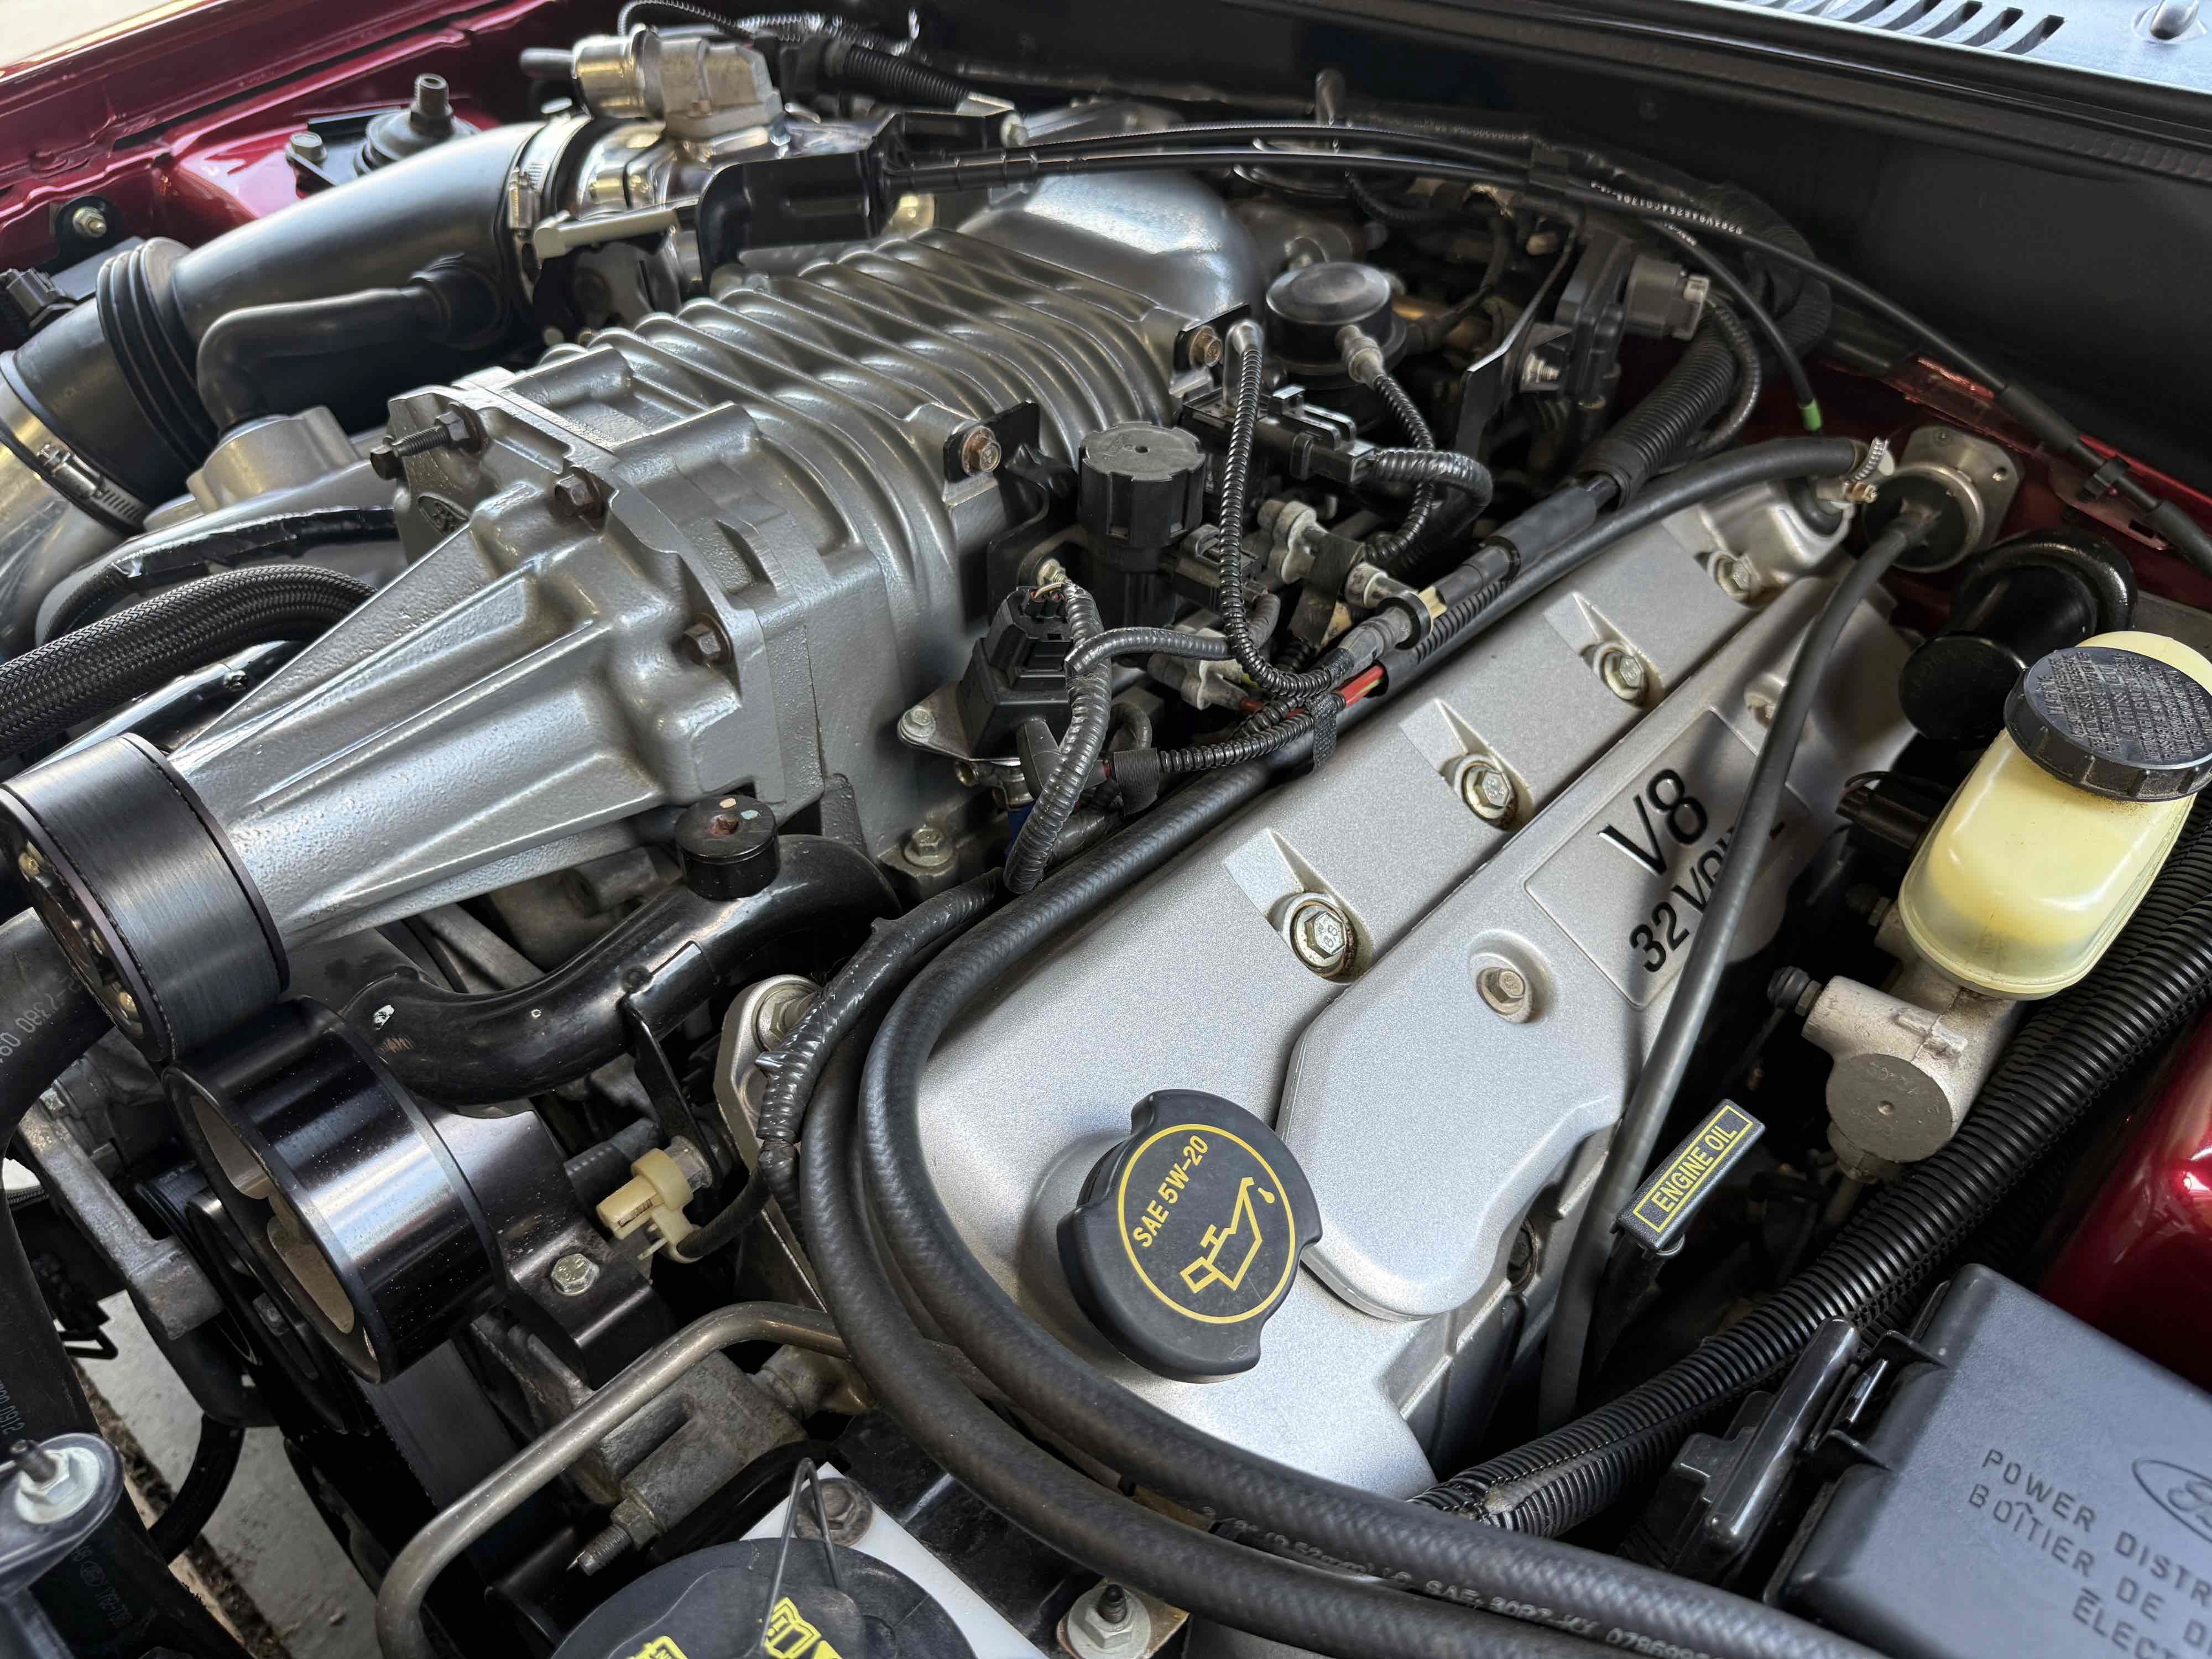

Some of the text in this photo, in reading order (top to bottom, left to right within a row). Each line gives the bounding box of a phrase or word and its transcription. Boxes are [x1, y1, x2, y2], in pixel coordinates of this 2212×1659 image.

[1597, 769, 1708, 875] V8
[1629, 901, 1690, 972] 32
[1133, 1135, 1209, 1248] SAE 5W-20
[1651, 1124, 1738, 1213] ENGINE OIL
[1981, 1448, 2097, 1533] POWER
[1968, 1483, 2095, 1578] BOÎTIER
[2115, 1575, 2166, 1623] DE
